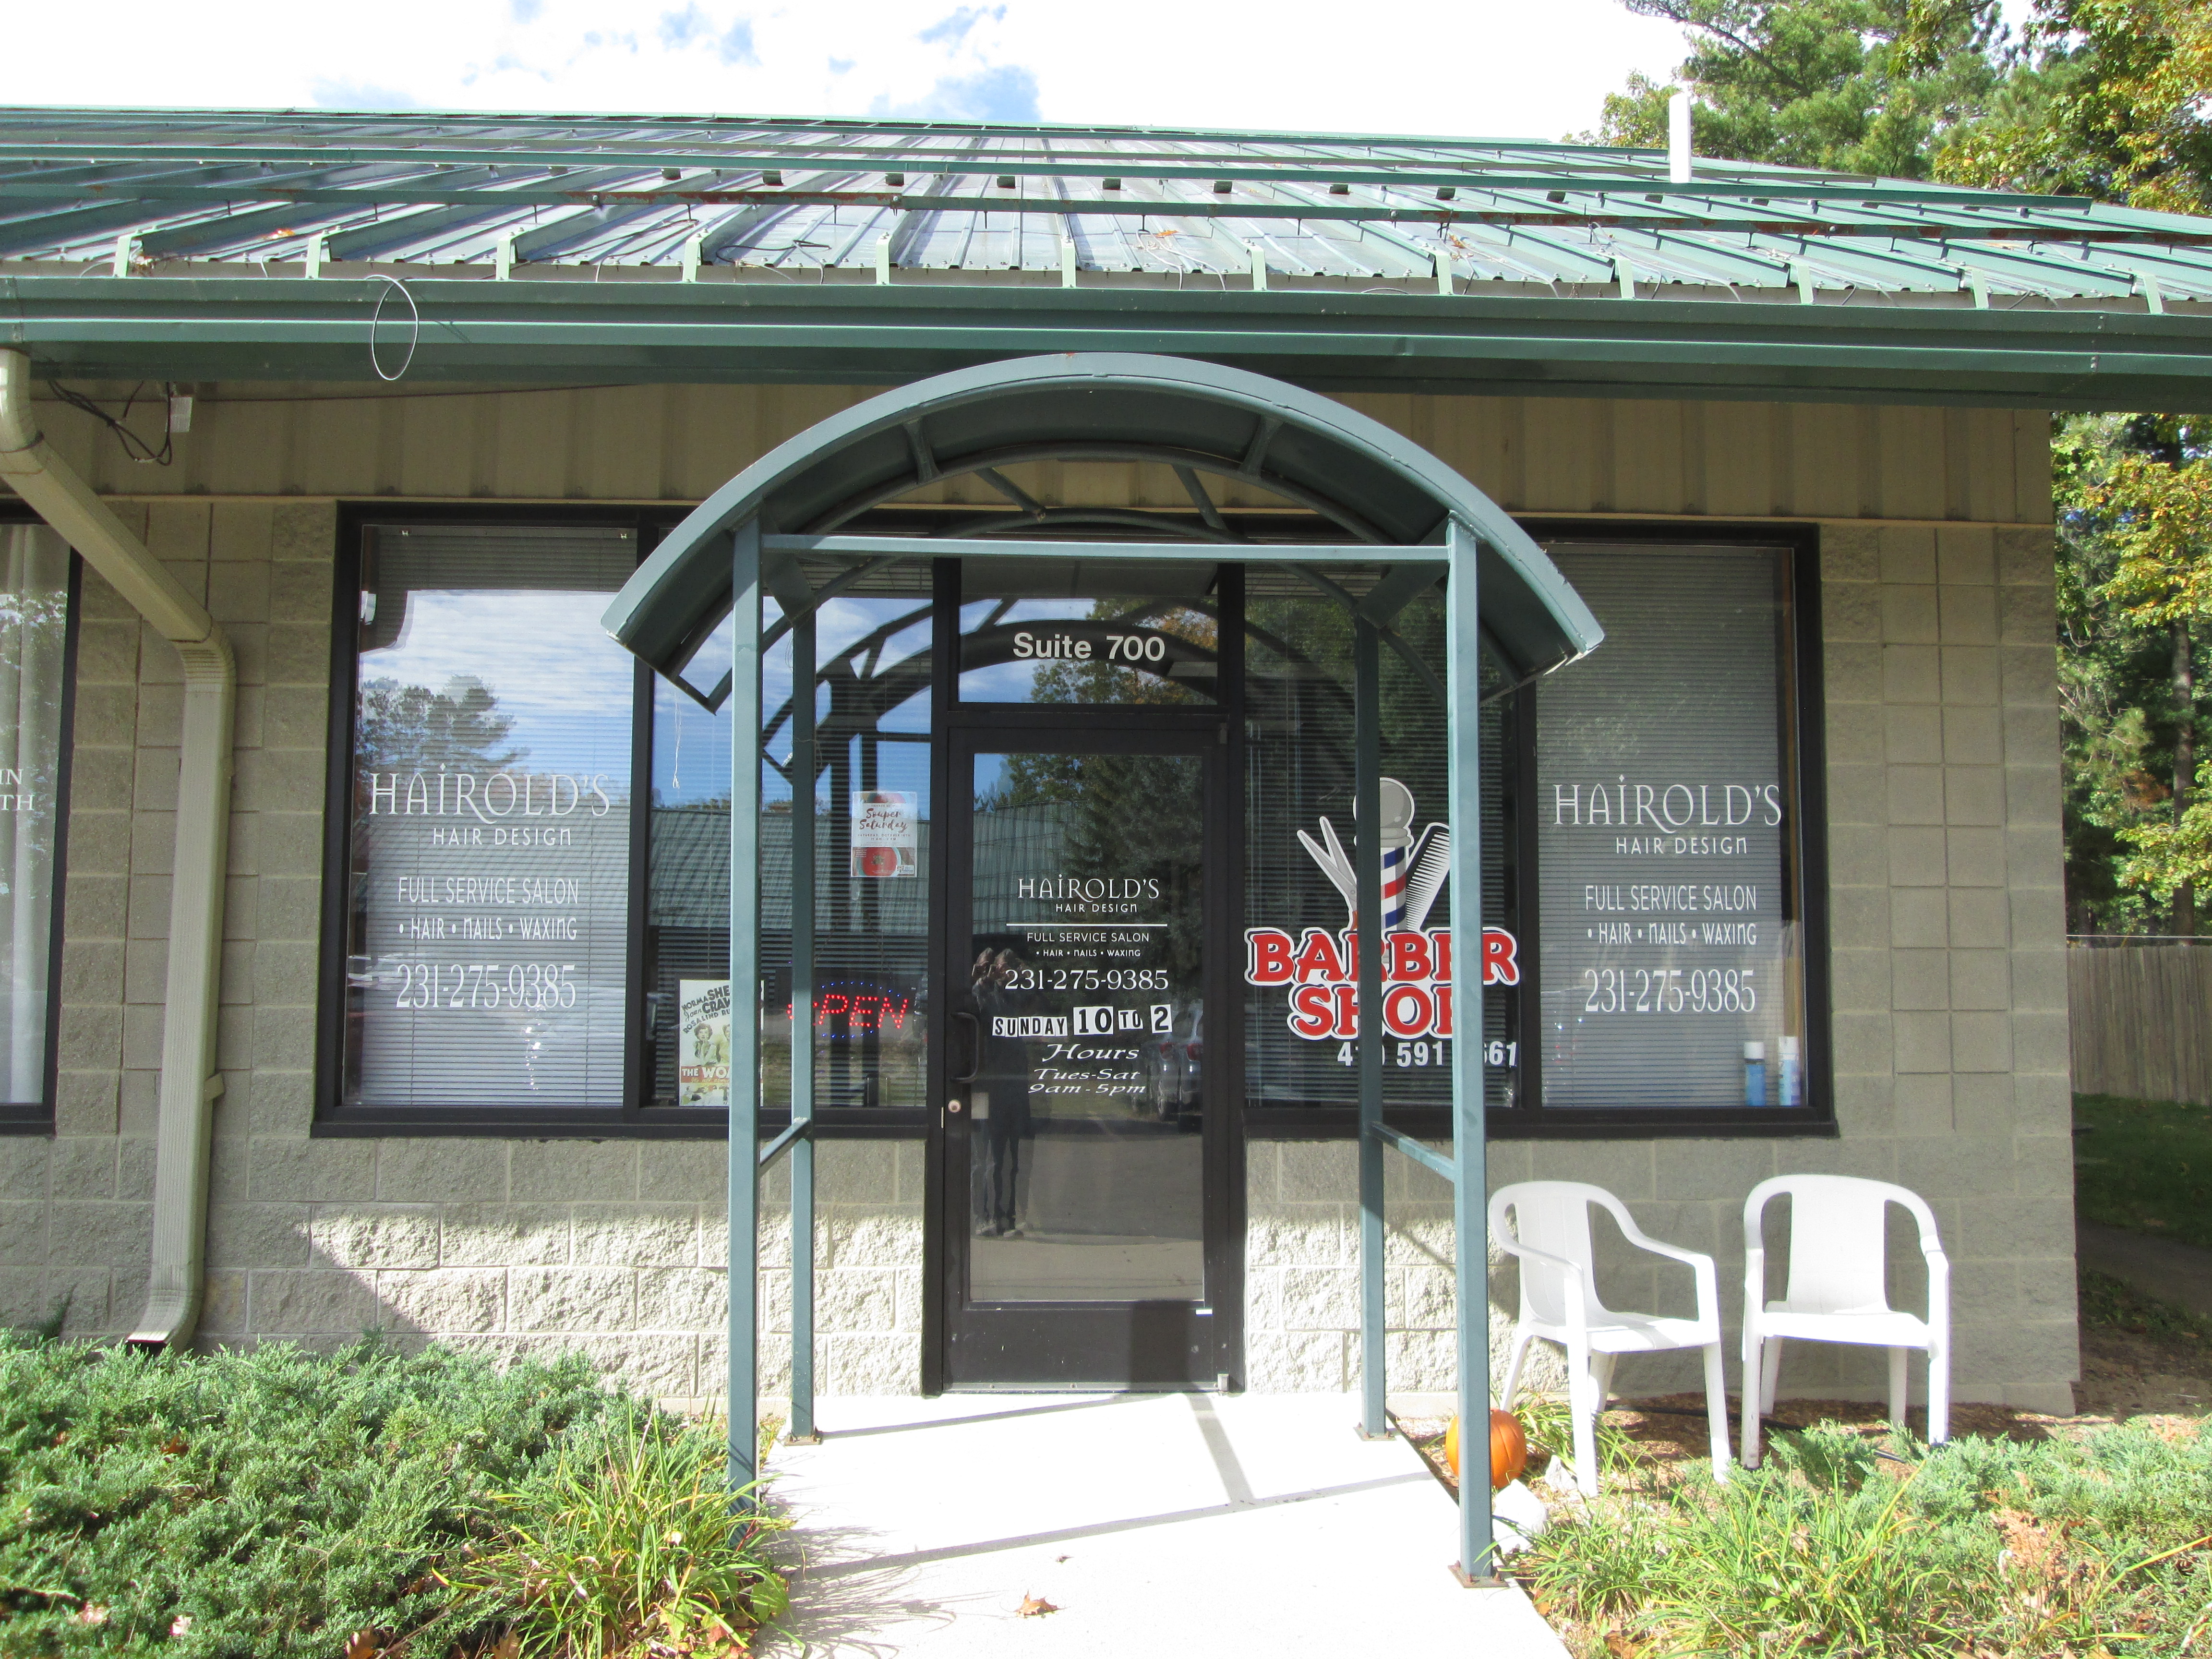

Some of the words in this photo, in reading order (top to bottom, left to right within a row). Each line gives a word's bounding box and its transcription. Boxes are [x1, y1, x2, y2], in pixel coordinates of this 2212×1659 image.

[1013, 632, 1092, 659] Suite
[1106, 635, 1165, 661] 700
[369, 763, 609, 824] HAIROLD'S
[1553, 774, 1781, 833] HAIROLD'S
[866, 808, 901, 821] Souper
[433, 828, 482, 845] HAIR
[494, 828, 571, 845] DESIGN
[859, 819, 908, 833] Saturday
[1616, 837, 1664, 854] HAIR
[1675, 837, 1746, 854] DESIGN
[398, 878, 438, 902] FULL
[446, 878, 516, 903] SERVICE
[522, 878, 578, 904] SALON
[1018, 874, 1160, 902] HAIROLD'S
[1586, 885, 1624, 911] FULL
[1631, 885, 1697, 911] SERVICE
[1703, 885, 1756, 911] SALON
[1056, 903, 1085, 913] HAIR
[1092, 903, 1138, 913] DESIGN
[410, 917, 445, 939] HAIR
[463, 917, 502, 940] NAILS
[519, 917, 577, 940] WAXING
[1027, 933, 1055, 942] FULL
[1059, 933, 1107, 942] SERVICE
[1111, 933, 1150, 942] SALON
[1599, 923, 1632, 944] HAIR
[1648, 922, 1686, 945] NAILS
[1702, 923, 1757, 946] WAXING
[397, 964, 576, 1009] 231-275-9385
[1005, 969, 1169, 990] 231-275-9385
[681, 996, 709, 1011] NORMA
[707, 985, 731, 1000] SHE
[1585, 969, 1755, 1013] 231-275-9385
[683, 1009, 702, 1022] Joan
[683, 1012, 719, 1034] ROSALIND
[995, 1018, 1066, 1036] SUNDAY
[1078, 1008, 1112, 1033] 10
[1120, 1010, 1142, 1029] TO
[1154, 1006, 1169, 1032] 2
[1042, 1044, 1140, 1062] Hours
[1397, 1041, 1443, 1067] 591
[682, 1068, 699, 1076] THE
[702, 1066, 730, 1079] WO
[1034, 1068, 1141, 1080] Tues-Sat
[1028, 1083, 1081, 1094] 9am
[1095, 1083, 1145, 1097] 5pm
